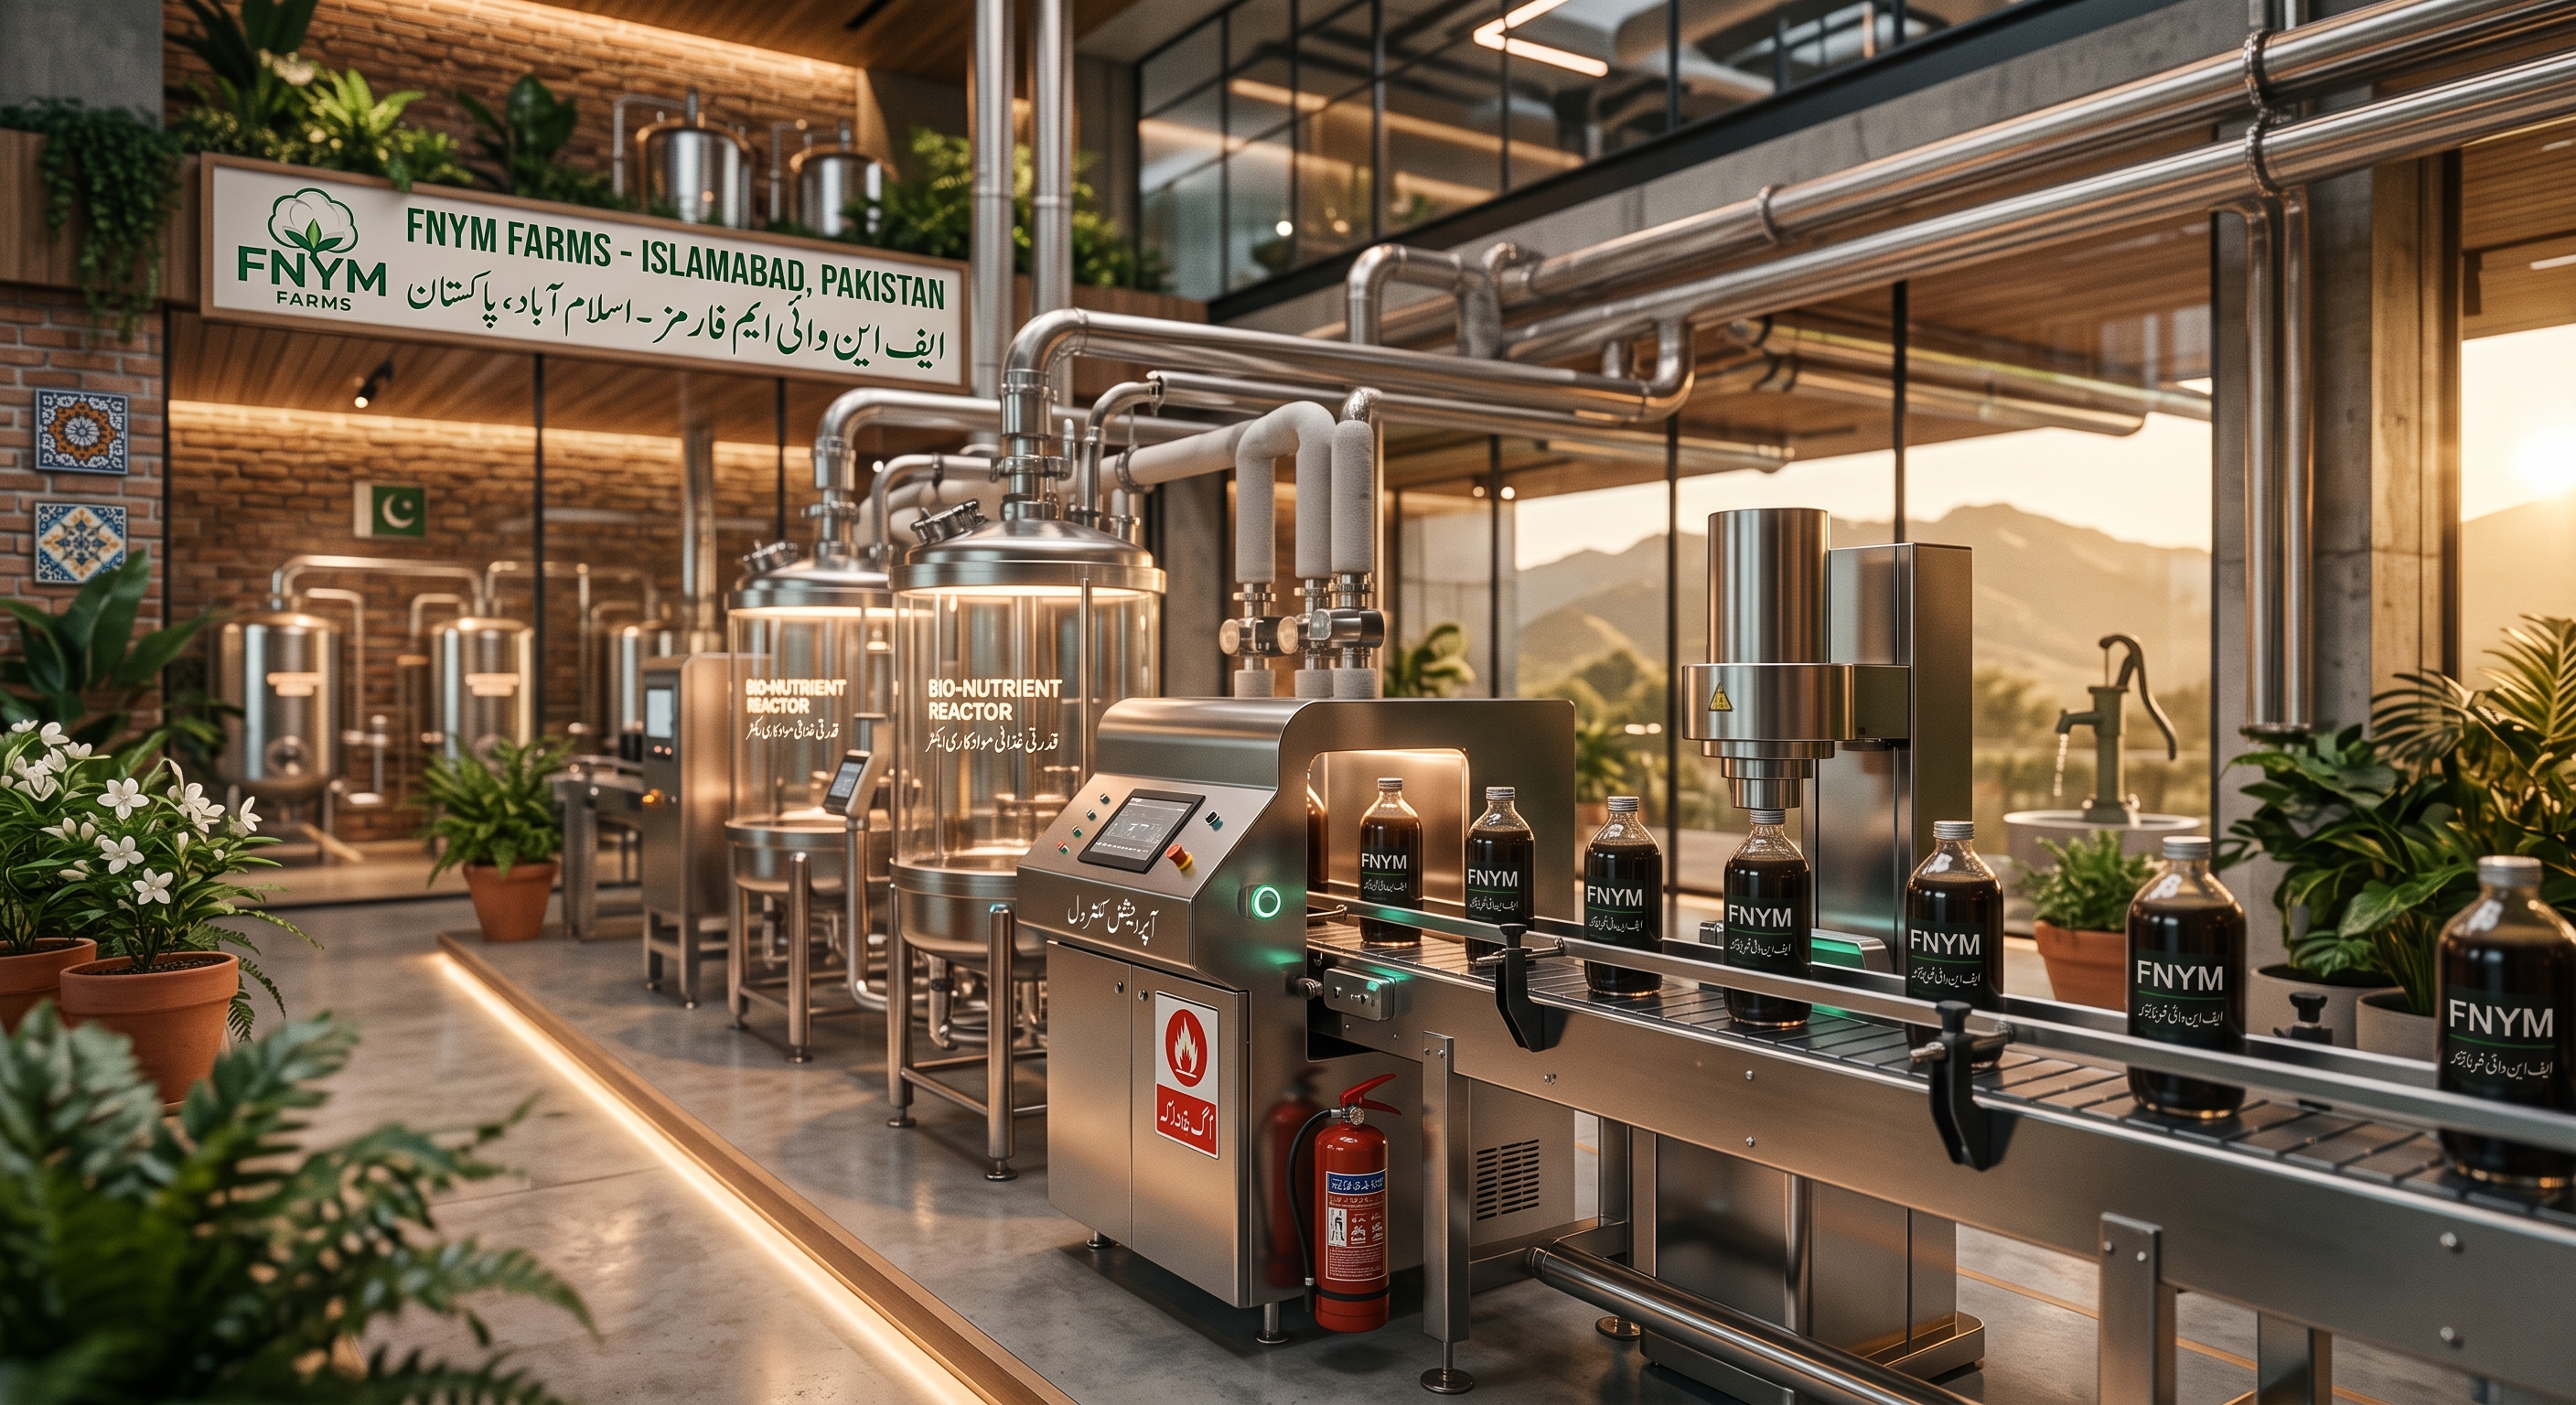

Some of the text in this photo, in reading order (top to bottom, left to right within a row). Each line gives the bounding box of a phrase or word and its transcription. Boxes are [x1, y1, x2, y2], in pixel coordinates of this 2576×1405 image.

[238, 245, 386, 297] FNYM
[407, 207, 497, 253] FNYM
[508, 220, 612, 268] FARMS
[642, 239, 813, 298] ISLAMABAD,
[821, 263, 945, 311] PAKISTAN
[276, 290, 352, 312] FARMS
[407, 269, 499, 329] پاکستان
[564, 293, 631, 338] اسلام
[652, 304, 726, 344] فارمز
[733, 301, 770, 356] ایم
[777, 294, 829, 356] وائی
[833, 323, 880, 368] این
[886, 327, 945, 370] ایف
[746, 679, 847, 696] BIO-NUTRIENT
[928, 679, 1063, 698] BIO-NUTRIENT
[746, 697, 810, 714] REACTOR
[928, 702, 1013, 721] REACTOR
[1361, 853, 1407, 869] FNYM
[1468, 868, 1519, 887] FNYM
[1587, 885, 1643, 906] FNYM
[1729, 904, 1792, 928] FNYM
[1910, 928, 1980, 956] FNYM
[2137, 960, 2223, 992] FNYM
[2449, 998, 2554, 1038] FNYM
